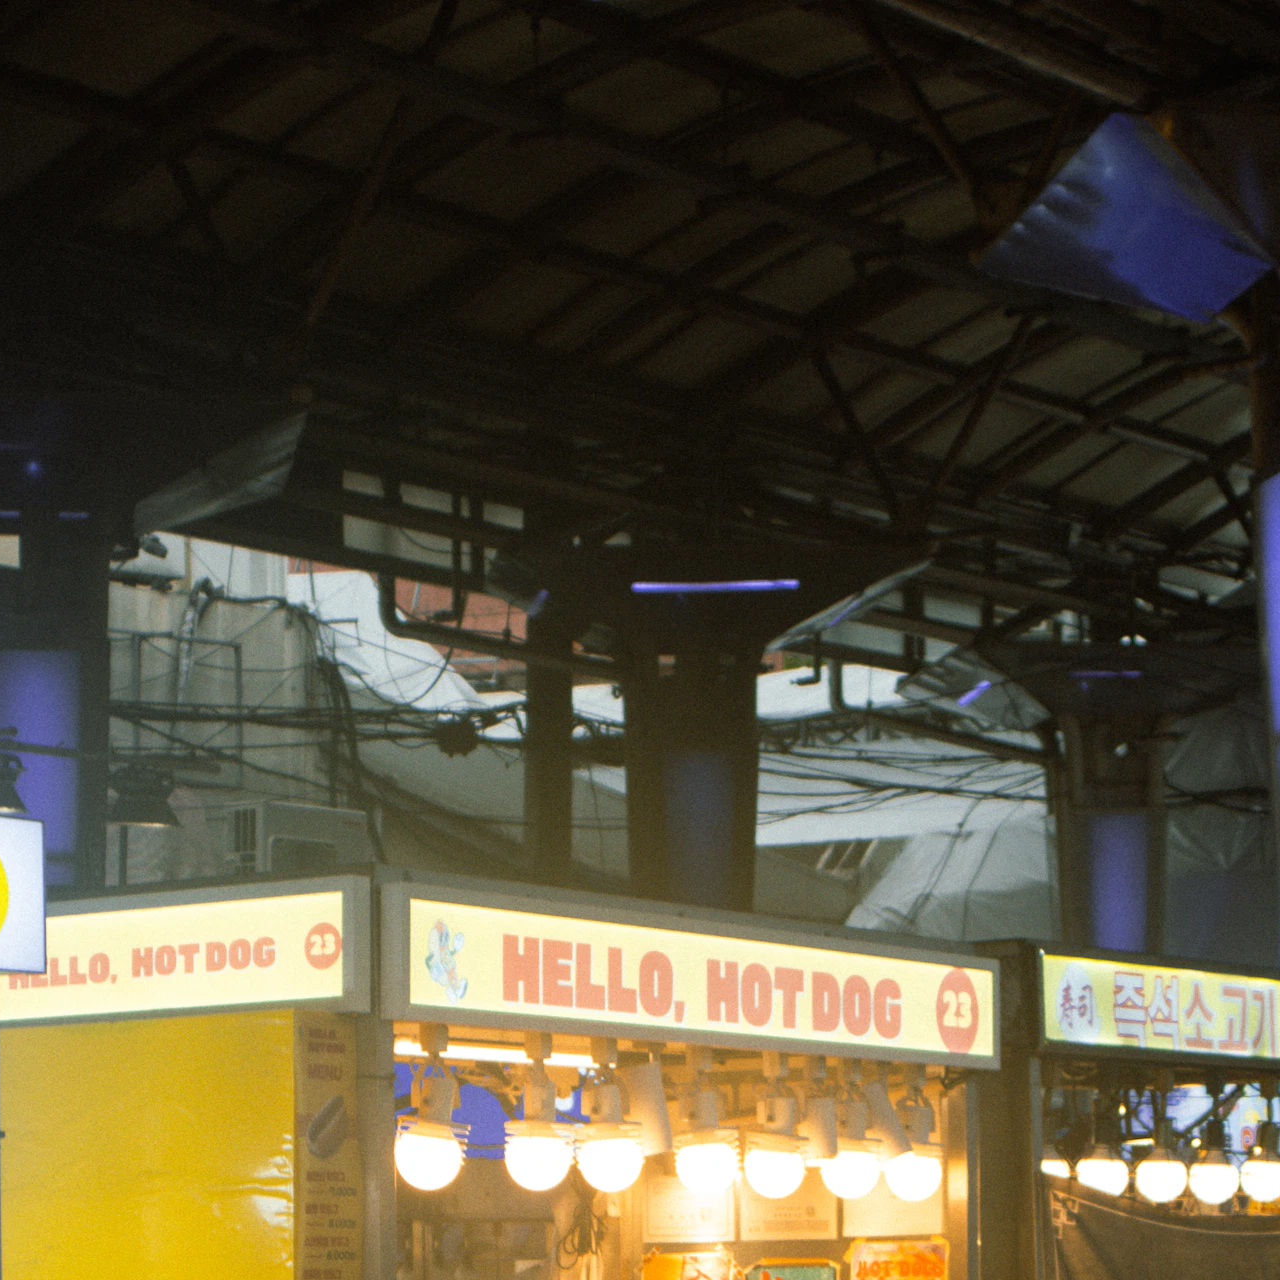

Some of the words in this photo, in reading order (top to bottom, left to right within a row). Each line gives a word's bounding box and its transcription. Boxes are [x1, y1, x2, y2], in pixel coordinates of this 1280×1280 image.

[309, 933, 336, 956] 23
[503, 934, 686, 1023] HELLO,
[943, 990, 972, 1028] 23
[856, 1261, 893, 1279] HOT
[899, 1259, 946, 1278] DOGS
